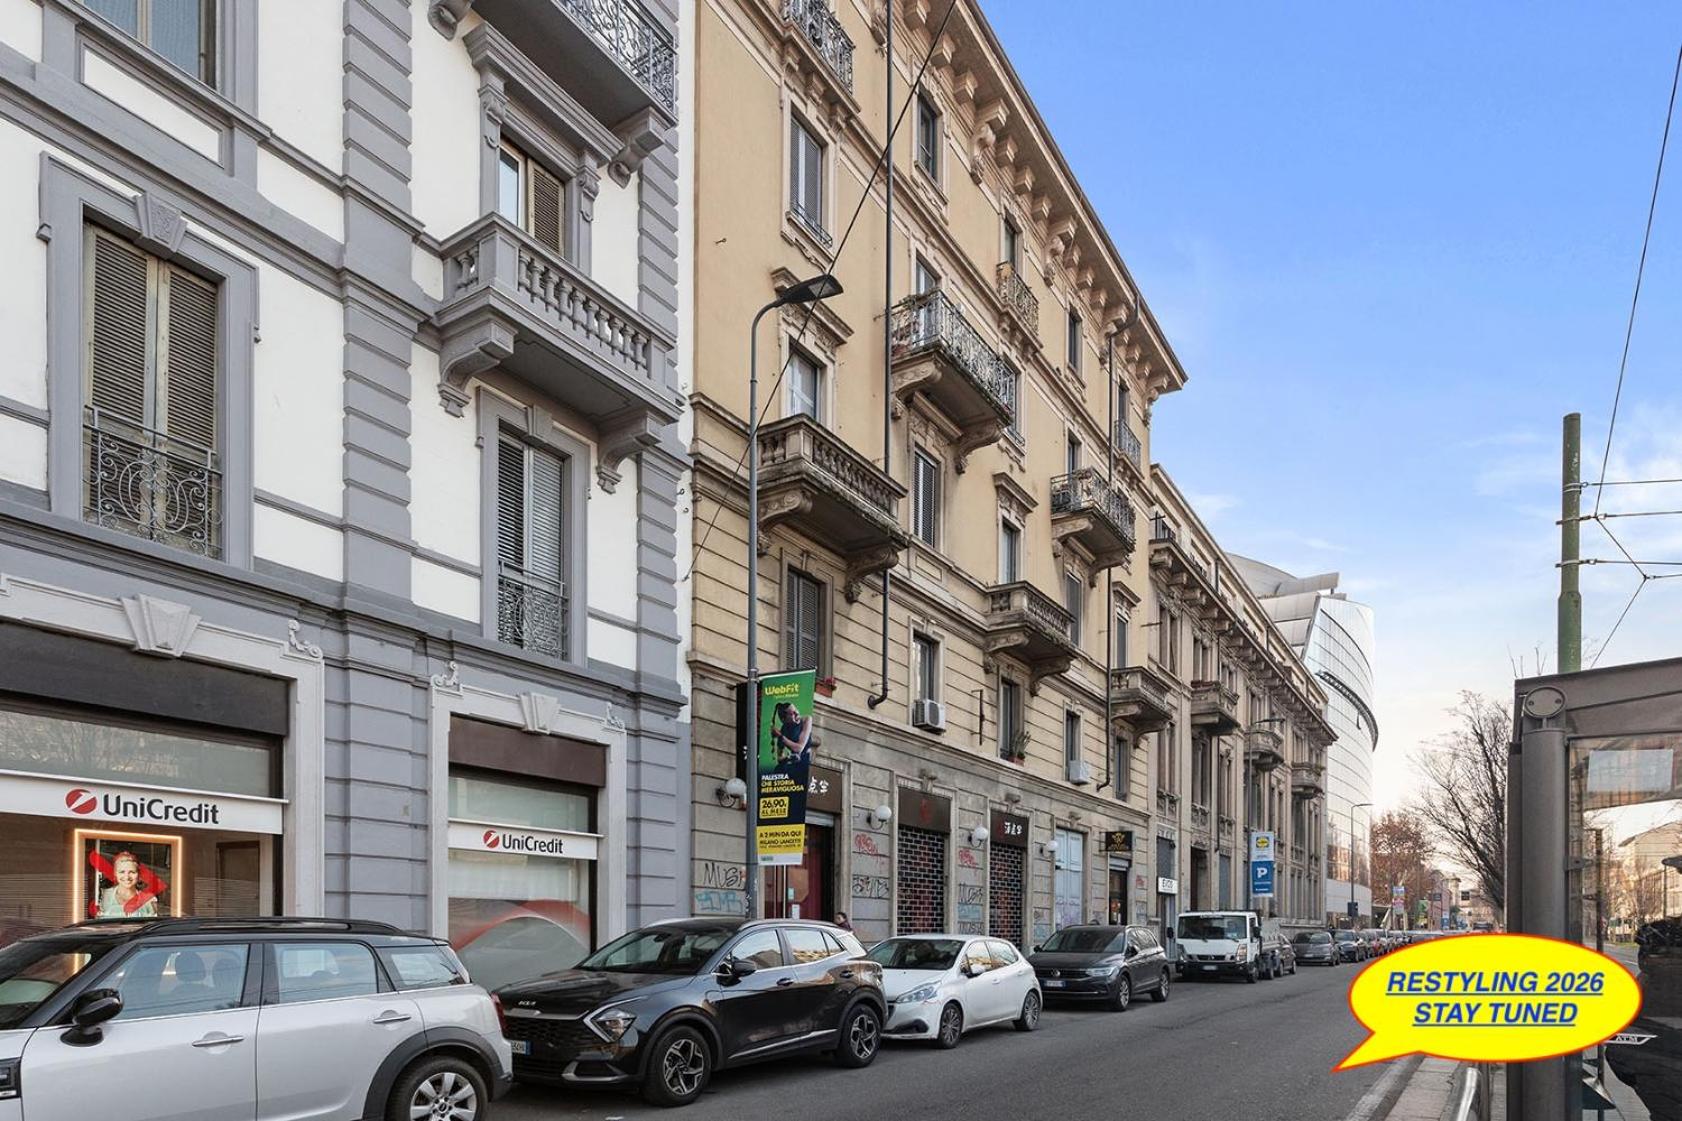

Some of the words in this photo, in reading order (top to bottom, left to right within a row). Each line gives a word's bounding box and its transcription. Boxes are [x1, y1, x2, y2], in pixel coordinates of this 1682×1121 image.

[765, 683, 800, 695] WebFit
[761, 785, 805, 793] MERAVIGLIOSA
[103, 794, 219, 824] UniCredit
[502, 834, 563, 854] UniCredit
[1256, 867, 1268, 878] P
